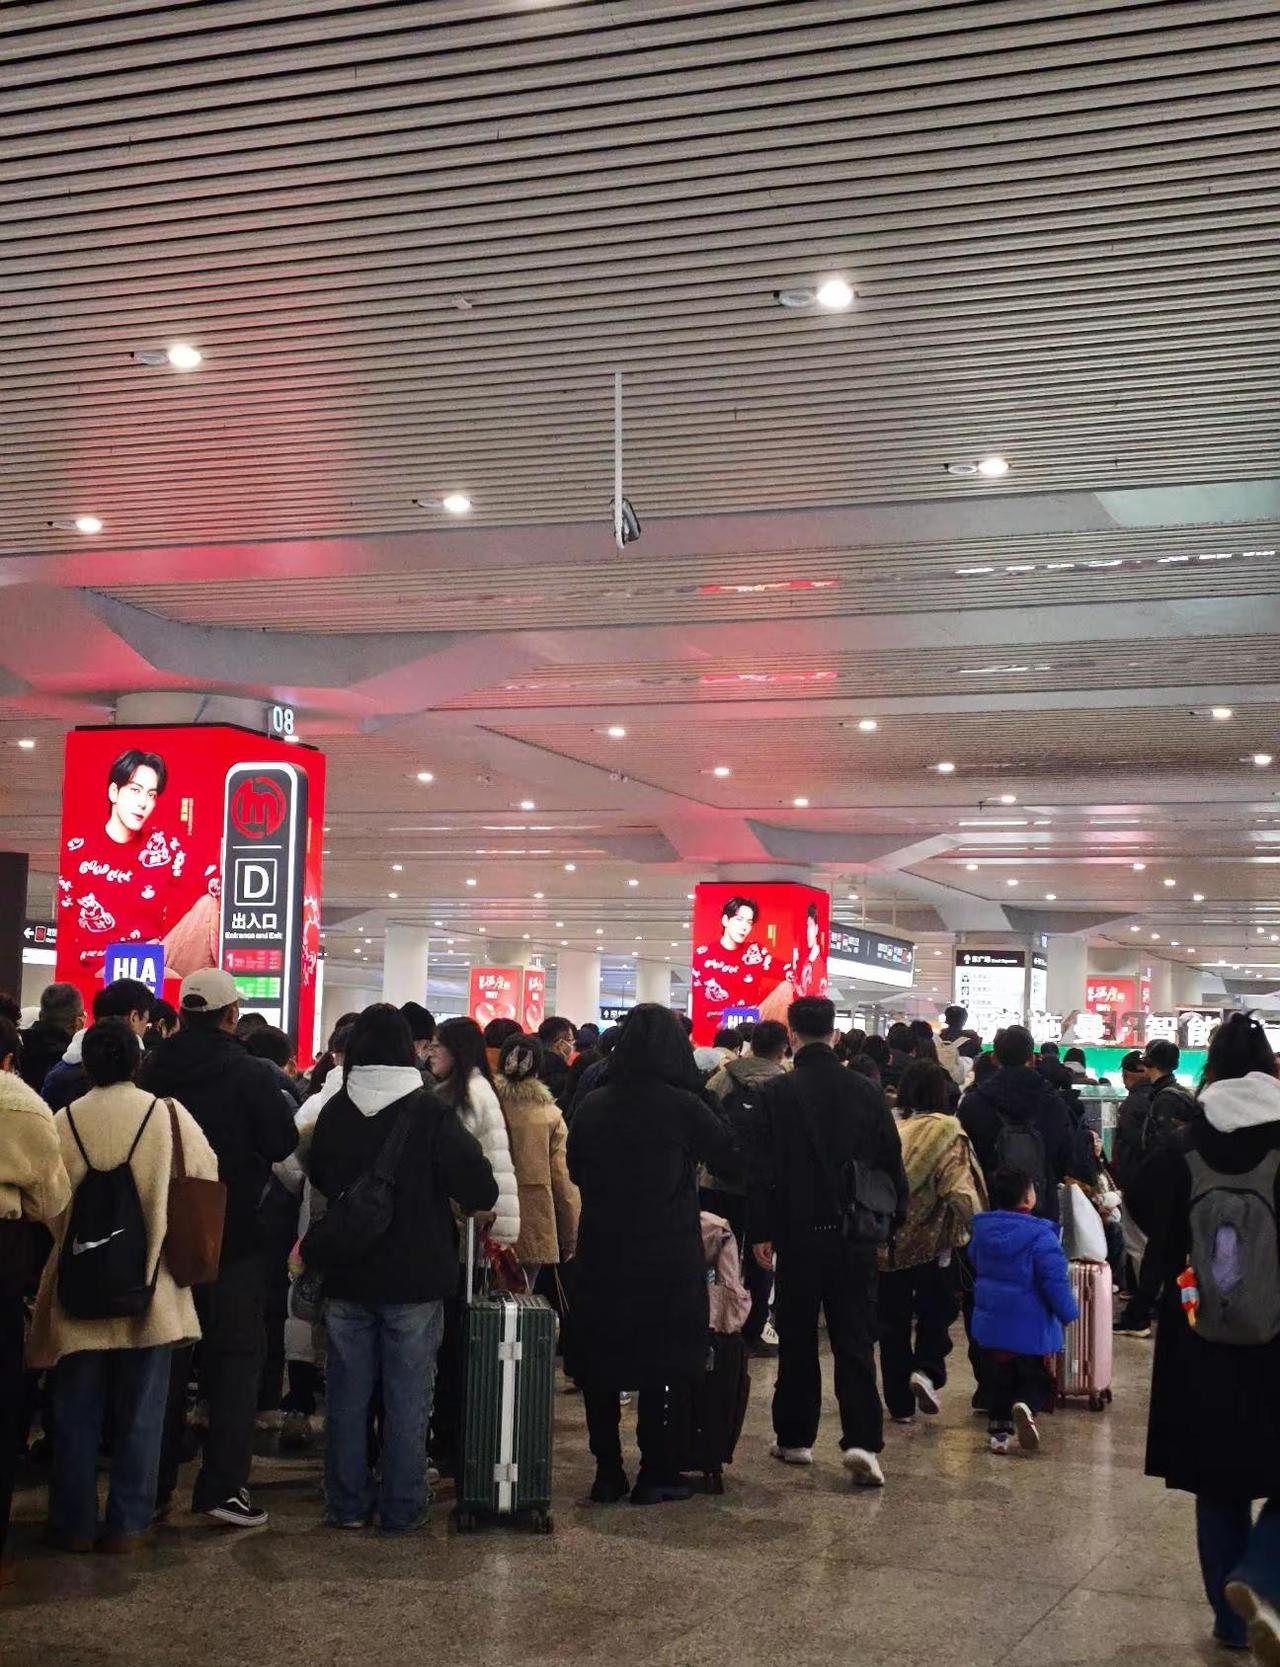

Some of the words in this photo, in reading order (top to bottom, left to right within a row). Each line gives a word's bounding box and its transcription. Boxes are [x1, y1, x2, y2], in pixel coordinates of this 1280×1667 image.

[273, 706, 294, 735] 08
[243, 865, 270, 899] D
[231, 912, 278, 930] 出入口
[113, 957, 157, 982] HLA
